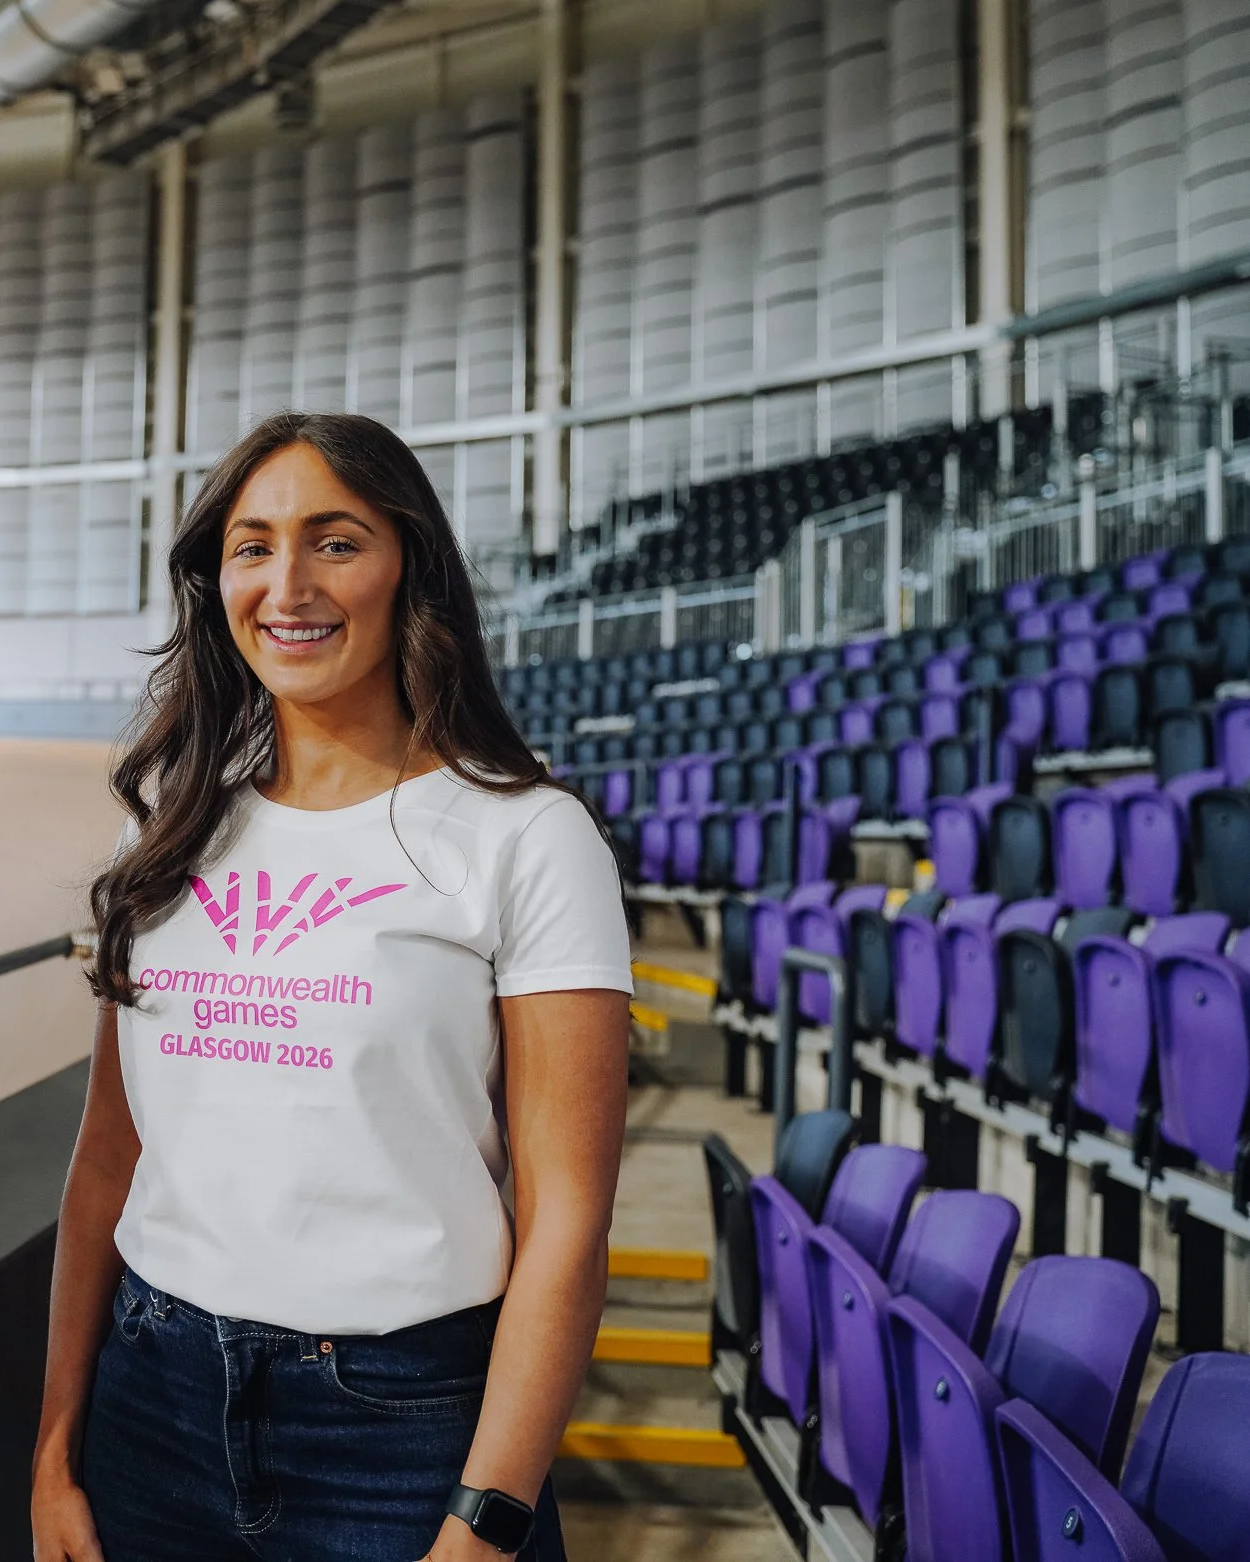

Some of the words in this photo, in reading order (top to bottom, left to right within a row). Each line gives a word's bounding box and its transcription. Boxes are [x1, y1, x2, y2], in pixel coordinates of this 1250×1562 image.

[139, 968, 372, 1005] commonwealth
[193, 998, 298, 1030] games
[160, 1033, 271, 1064] GLASGOW
[277, 1044, 333, 1070] 2026
